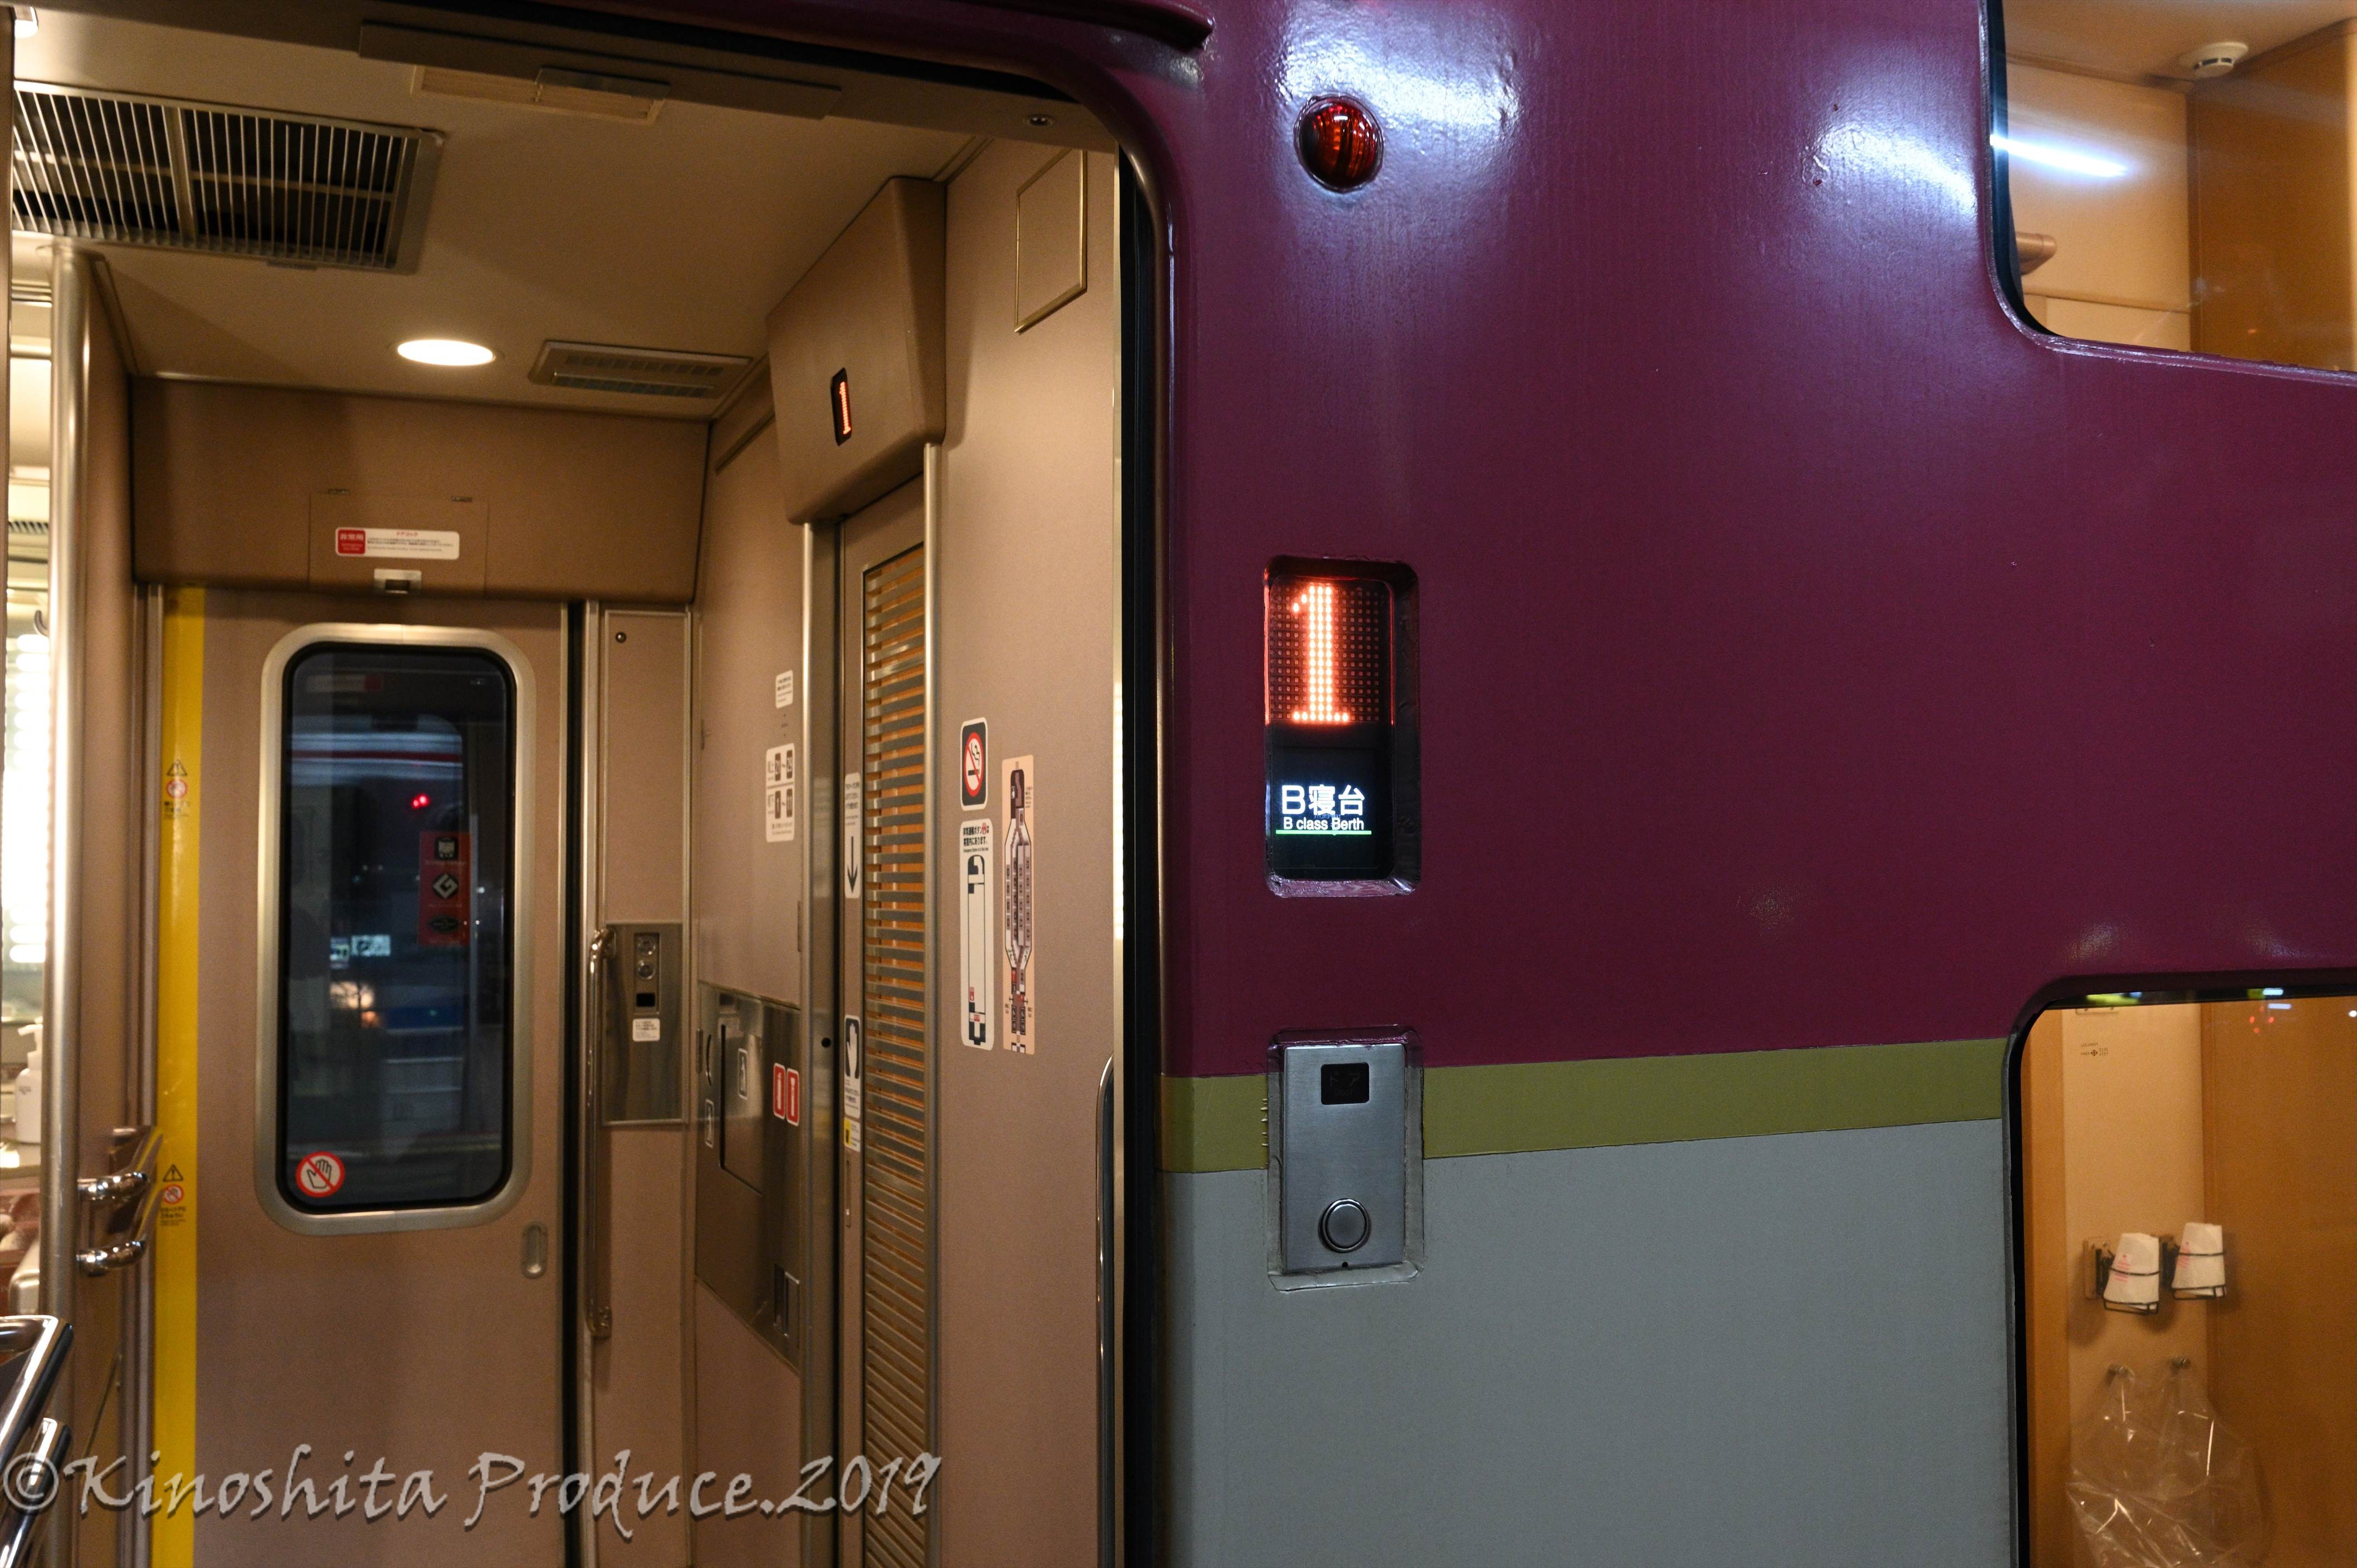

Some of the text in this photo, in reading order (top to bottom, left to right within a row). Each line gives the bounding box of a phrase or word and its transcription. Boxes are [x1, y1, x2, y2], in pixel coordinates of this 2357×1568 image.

[839, 381, 851, 435] 1
[1292, 584, 1350, 722] 1
[1281, 784, 1365, 816] B寝台
[1283, 817, 1364, 830] B class Berth
